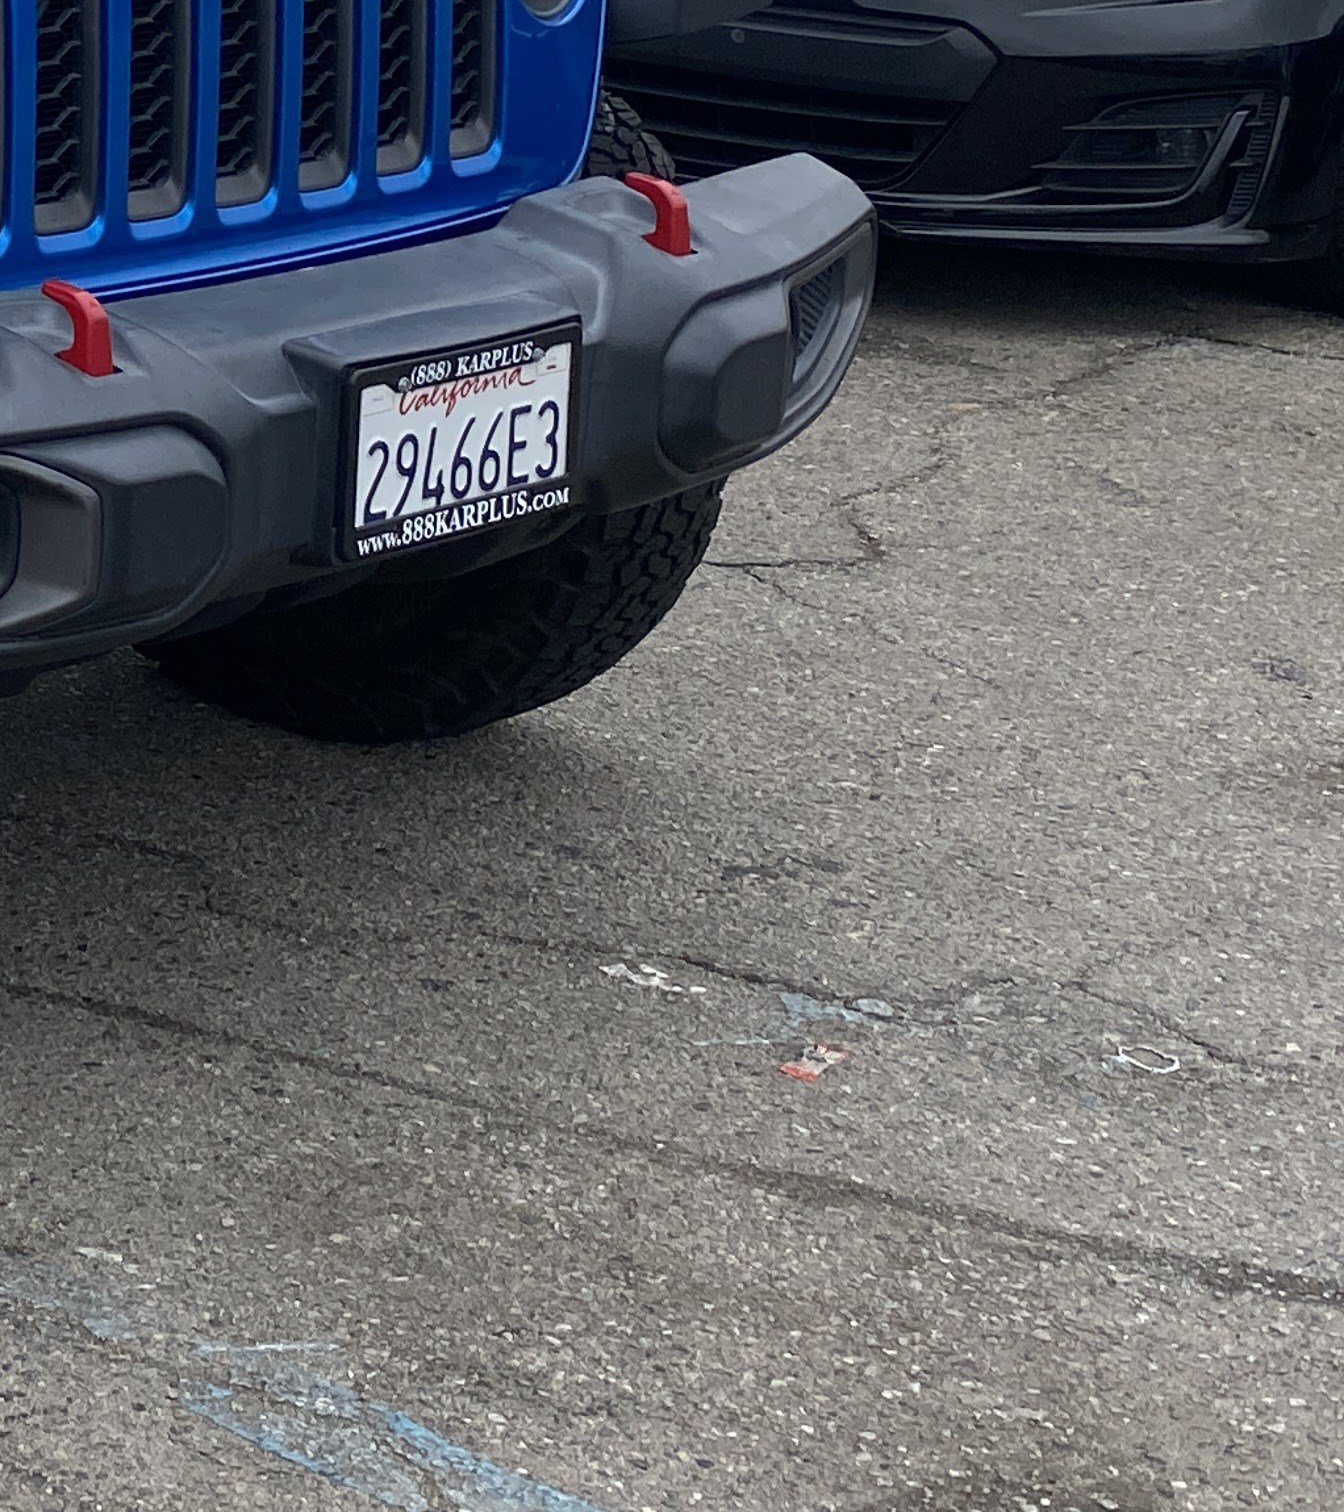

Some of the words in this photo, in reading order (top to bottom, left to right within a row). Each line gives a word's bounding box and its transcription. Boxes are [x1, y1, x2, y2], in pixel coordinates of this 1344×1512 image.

[411, 361, 452, 386] (888)
[455, 341, 534, 377] KARPLUS
[398, 365, 536, 418] California
[363, 399, 560, 525] 29466E3
